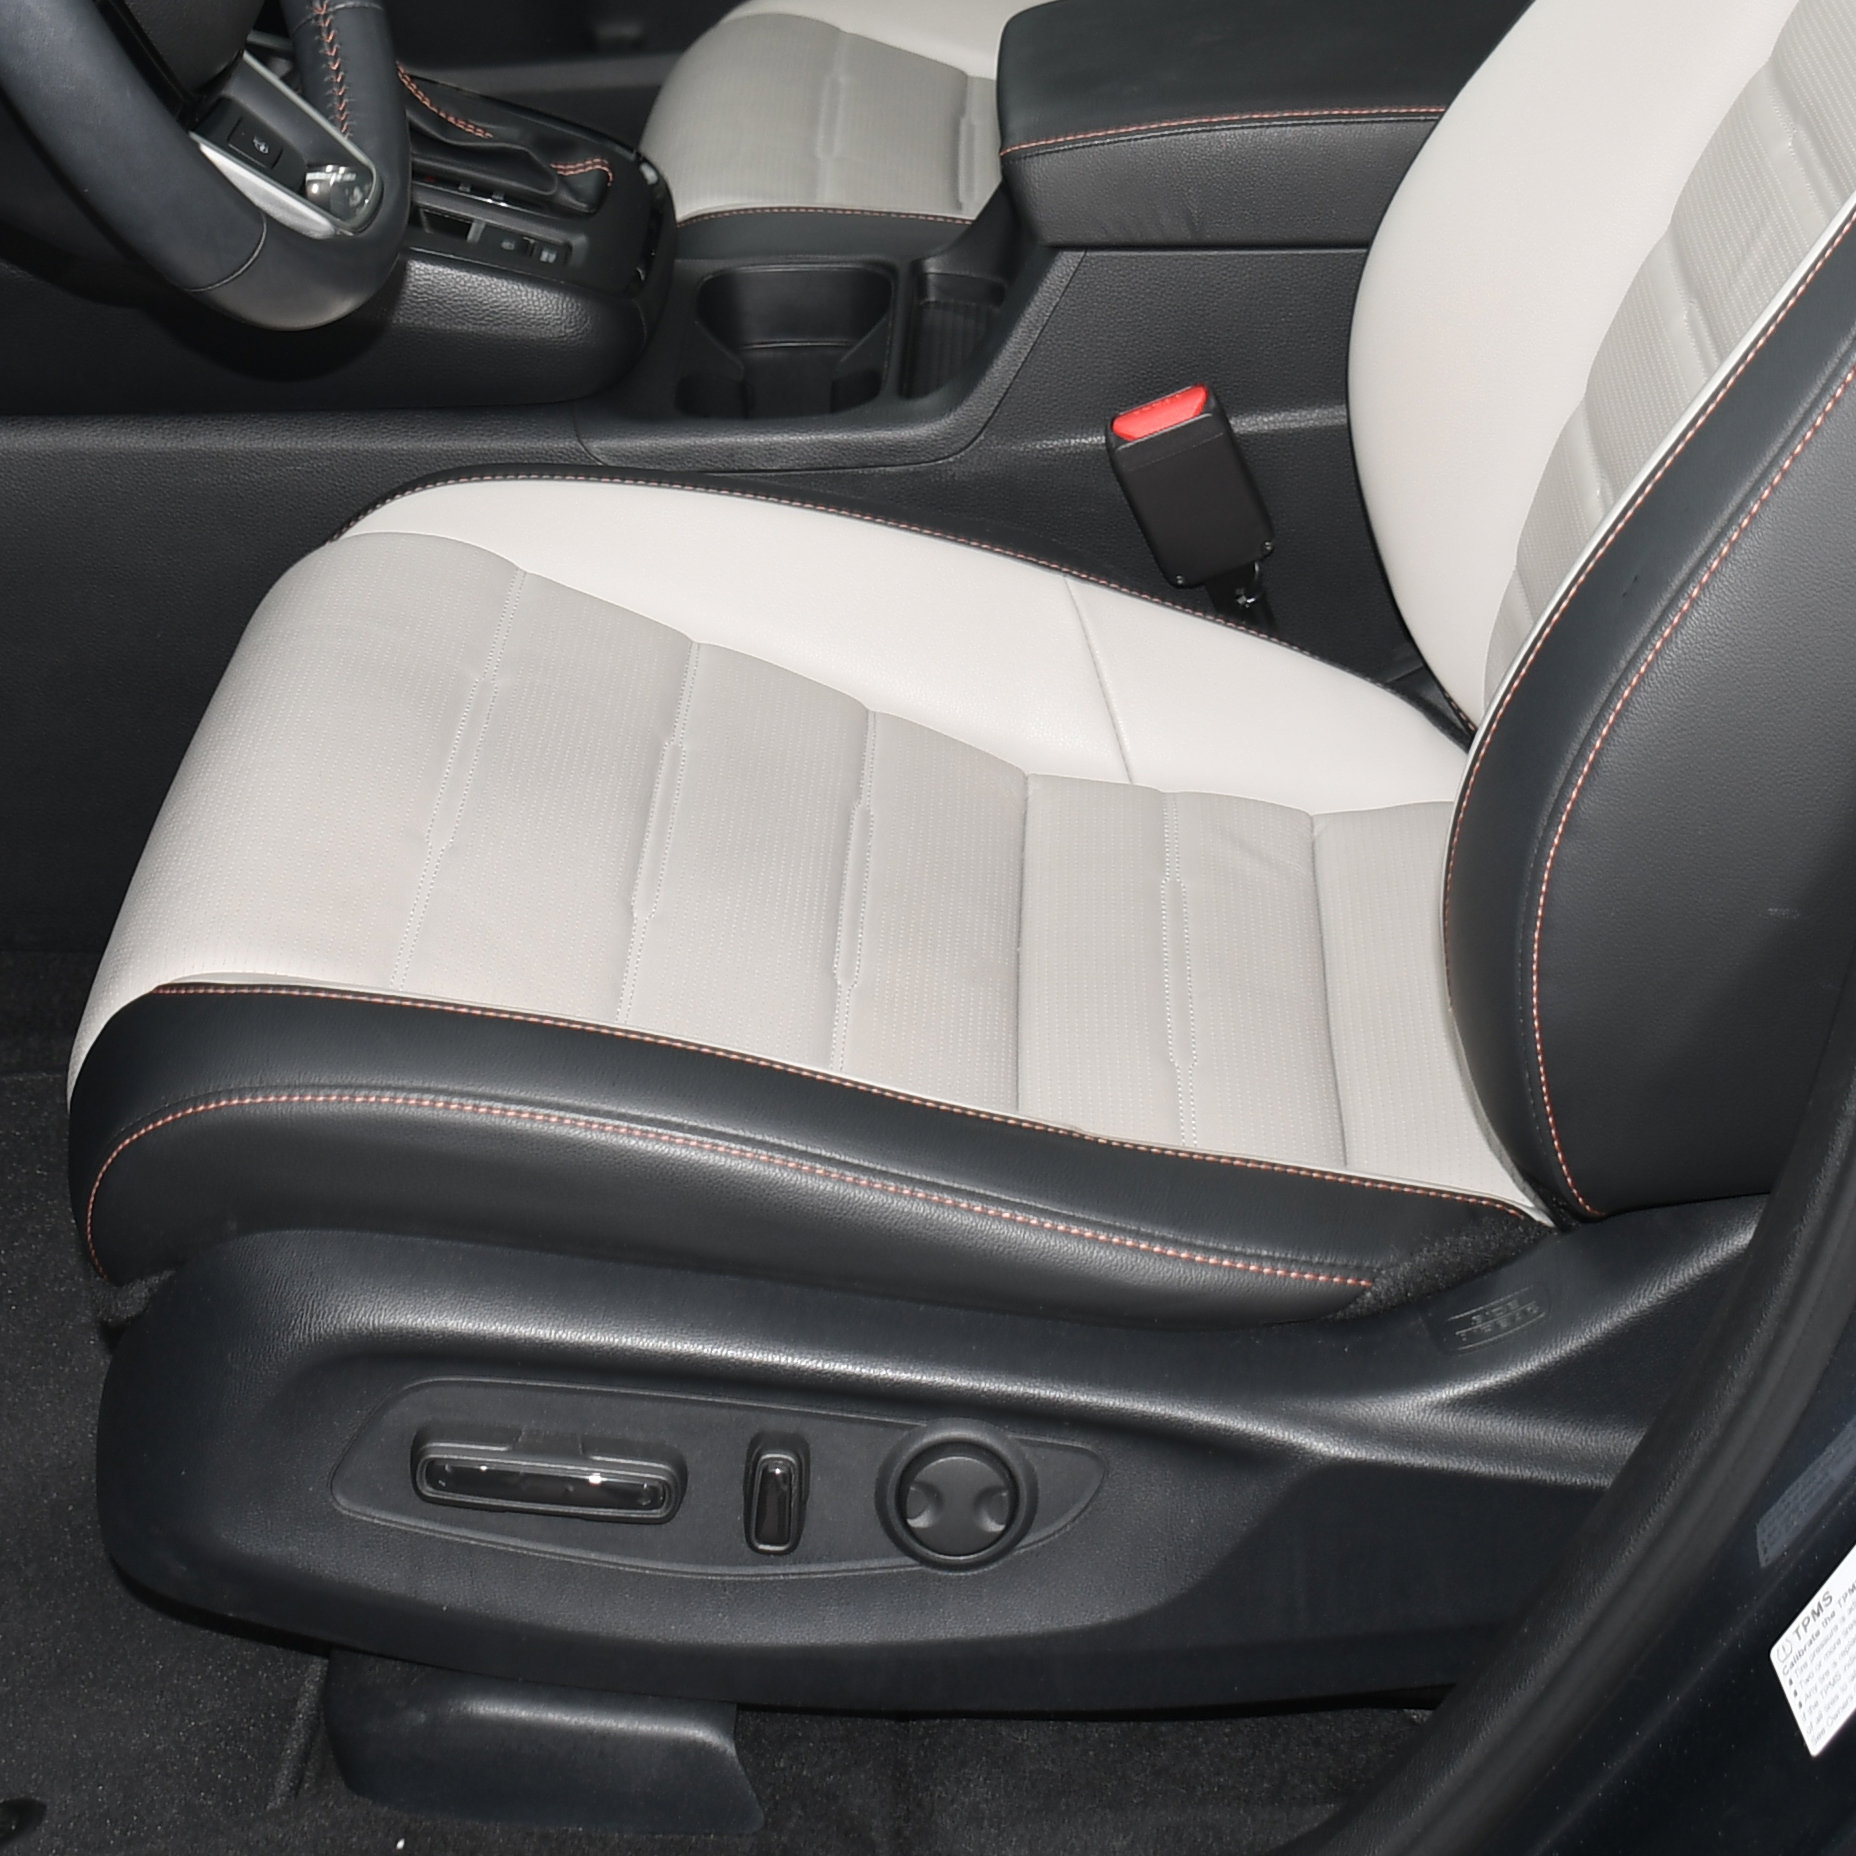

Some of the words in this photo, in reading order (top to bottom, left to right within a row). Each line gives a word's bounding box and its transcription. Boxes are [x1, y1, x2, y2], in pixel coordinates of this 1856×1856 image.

[1780, 1626, 1821, 1677] Calibrate
[1820, 1608, 1836, 1631] the
[1792, 1588, 1834, 1643] TPMS
